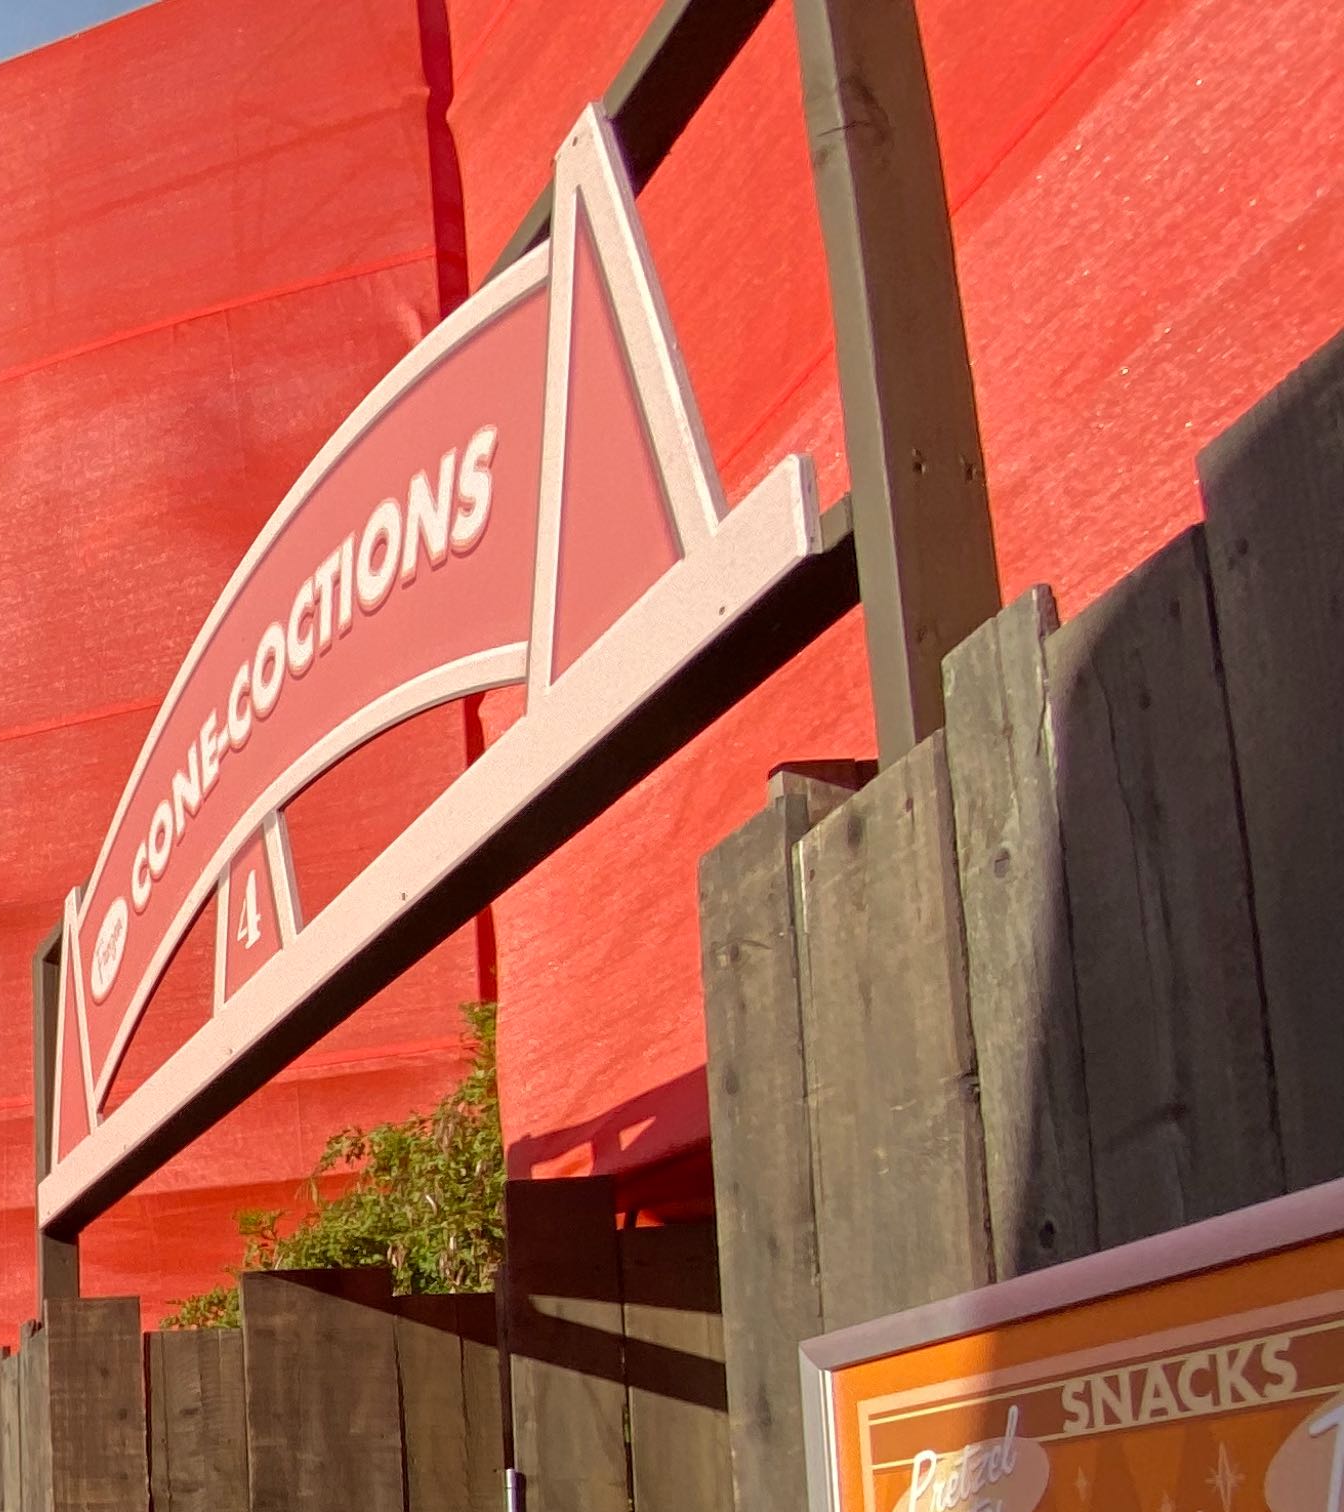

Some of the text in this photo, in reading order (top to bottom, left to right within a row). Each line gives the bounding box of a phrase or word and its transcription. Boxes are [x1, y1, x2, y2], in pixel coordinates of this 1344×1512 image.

[131, 425, 497, 912] CONE-COCTIONS
[236, 870, 262, 950] 4
[1061, 1337, 1299, 1434] SNACKS
